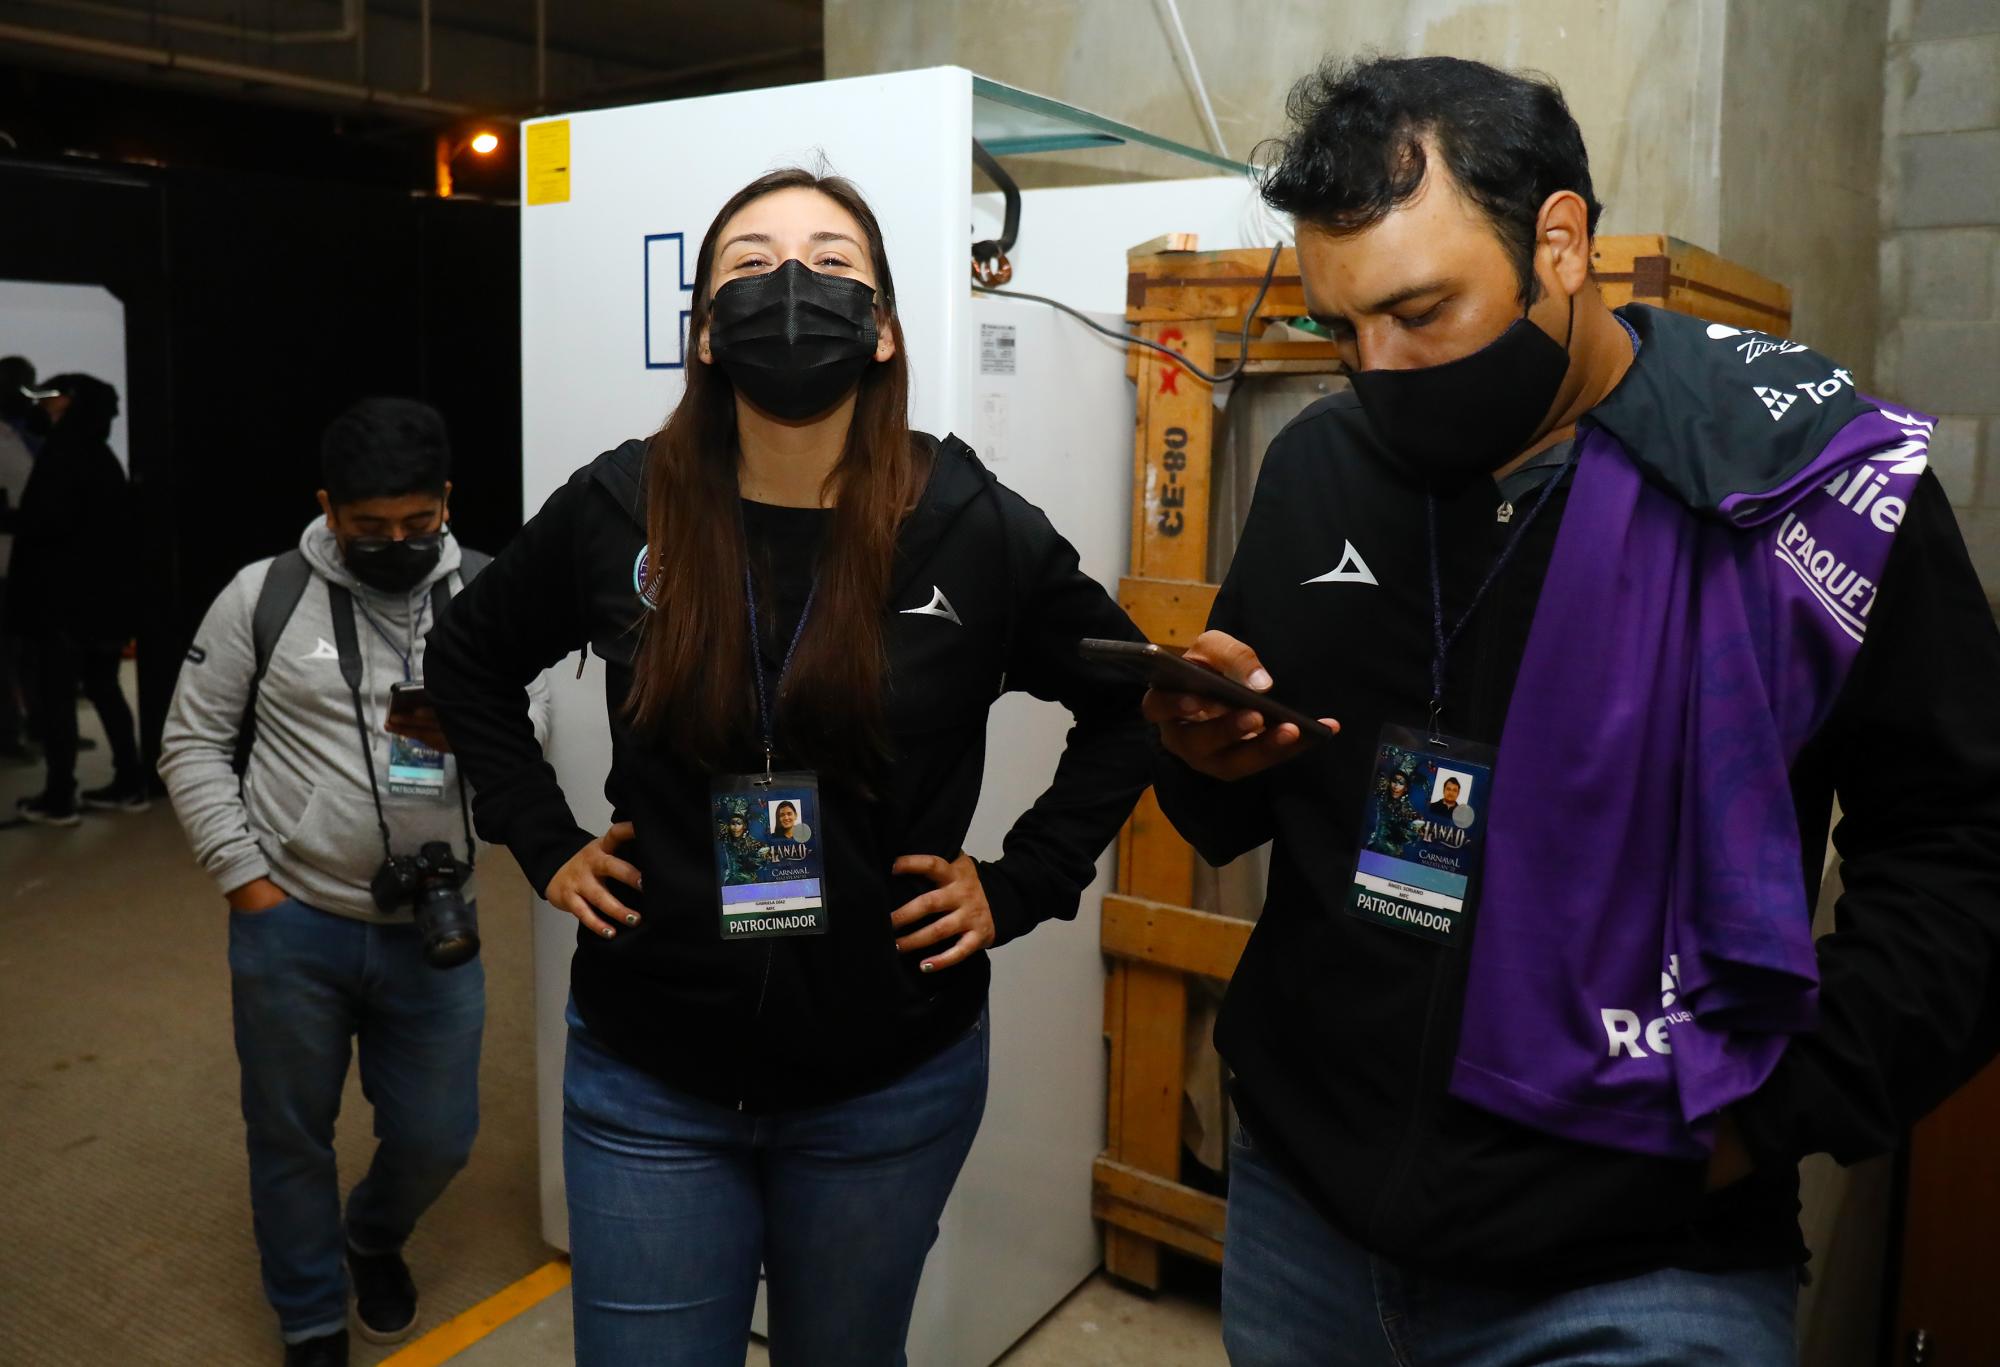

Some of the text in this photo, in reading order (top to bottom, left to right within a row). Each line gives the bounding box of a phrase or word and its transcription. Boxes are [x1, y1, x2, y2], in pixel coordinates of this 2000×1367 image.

[1796, 368, 1855, 404] Tot
[1158, 427, 1188, 537] CE-80
[771, 867, 809, 877] CARNAVAL
[1419, 850, 1460, 867] CARNAVAL
[729, 914, 817, 933] PATROCINADOR
[1356, 893, 1452, 934] PATROCINADOR
